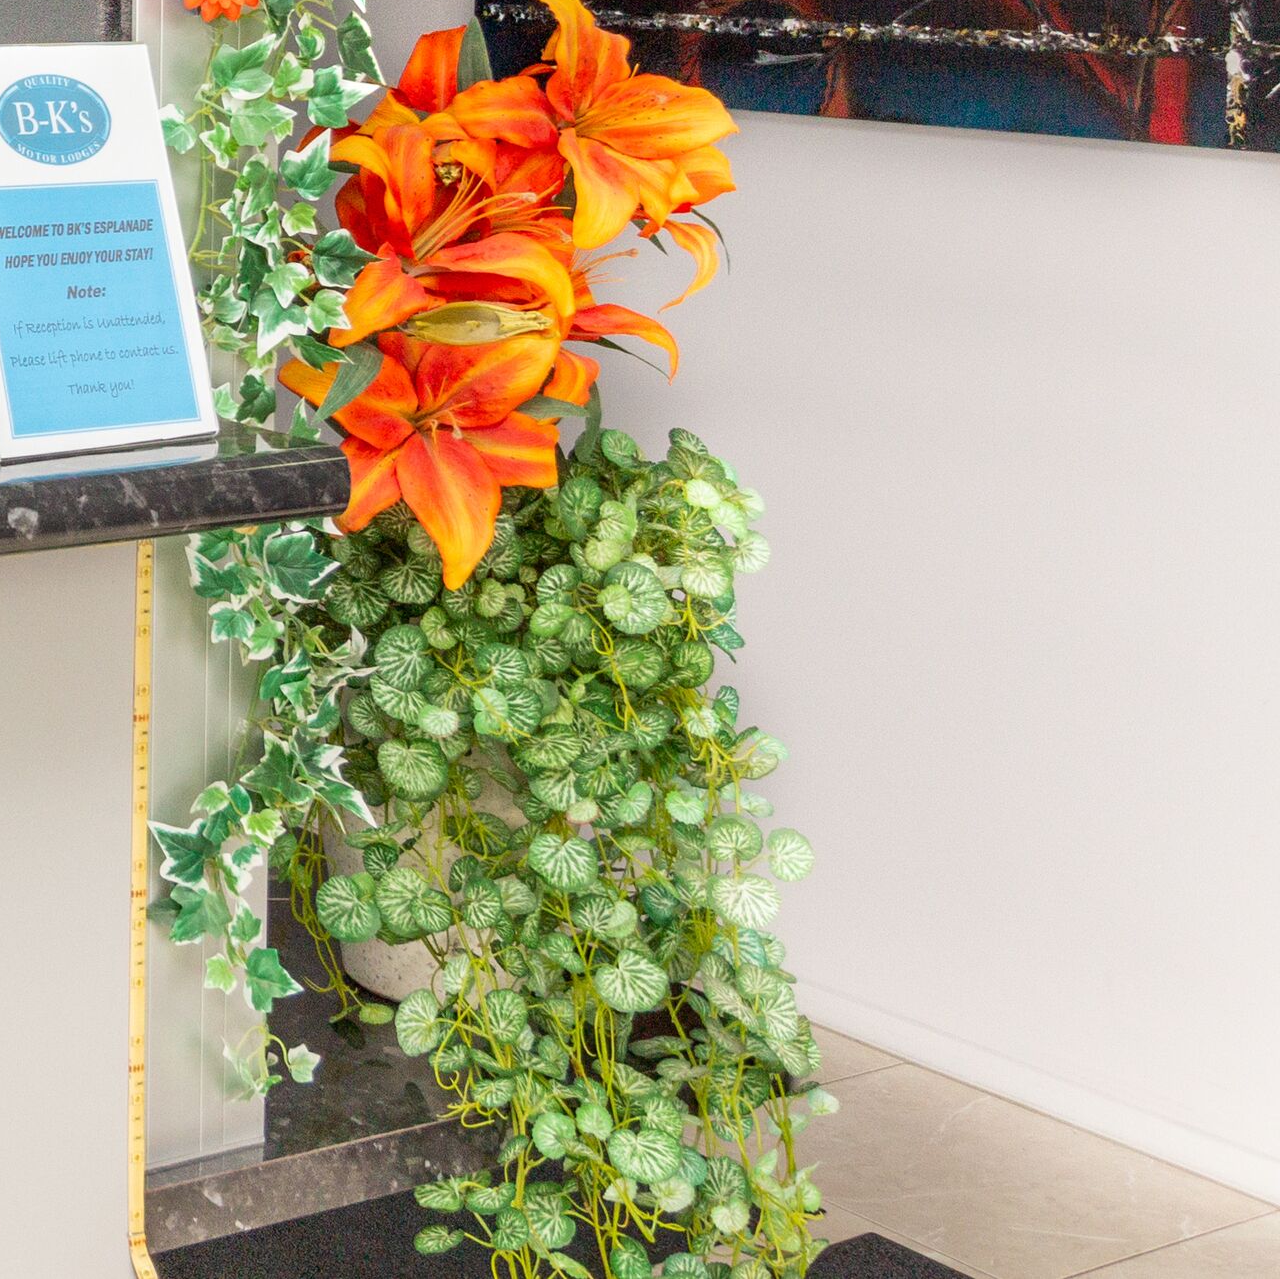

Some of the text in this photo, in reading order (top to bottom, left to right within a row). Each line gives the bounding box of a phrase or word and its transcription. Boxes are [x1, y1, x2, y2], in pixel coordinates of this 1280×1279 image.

[24, 75, 71, 90] QUALITY
[12, 100, 93, 136] B-K's
[15, 140, 101, 164] MOTOR LODGES
[51, 223, 65, 237] TO
[66, 221, 92, 236] BK'S
[93, 218, 154, 234] ESPLANADE
[4, 247, 154, 270] HOPE YOU ENJOY YOUR STAY!
[66, 285, 107, 300] Note:
[13, 320, 24, 338] If
[25, 318, 82, 336] Reception
[83, 316, 94, 330] is
[10, 354, 46, 368] Please
[69, 347, 103, 368] phone
[104, 348, 116, 360] to
[118, 344, 161, 360] contact
[162, 343, 179, 355] us.
[68, 378, 136, 398] Thank you!
